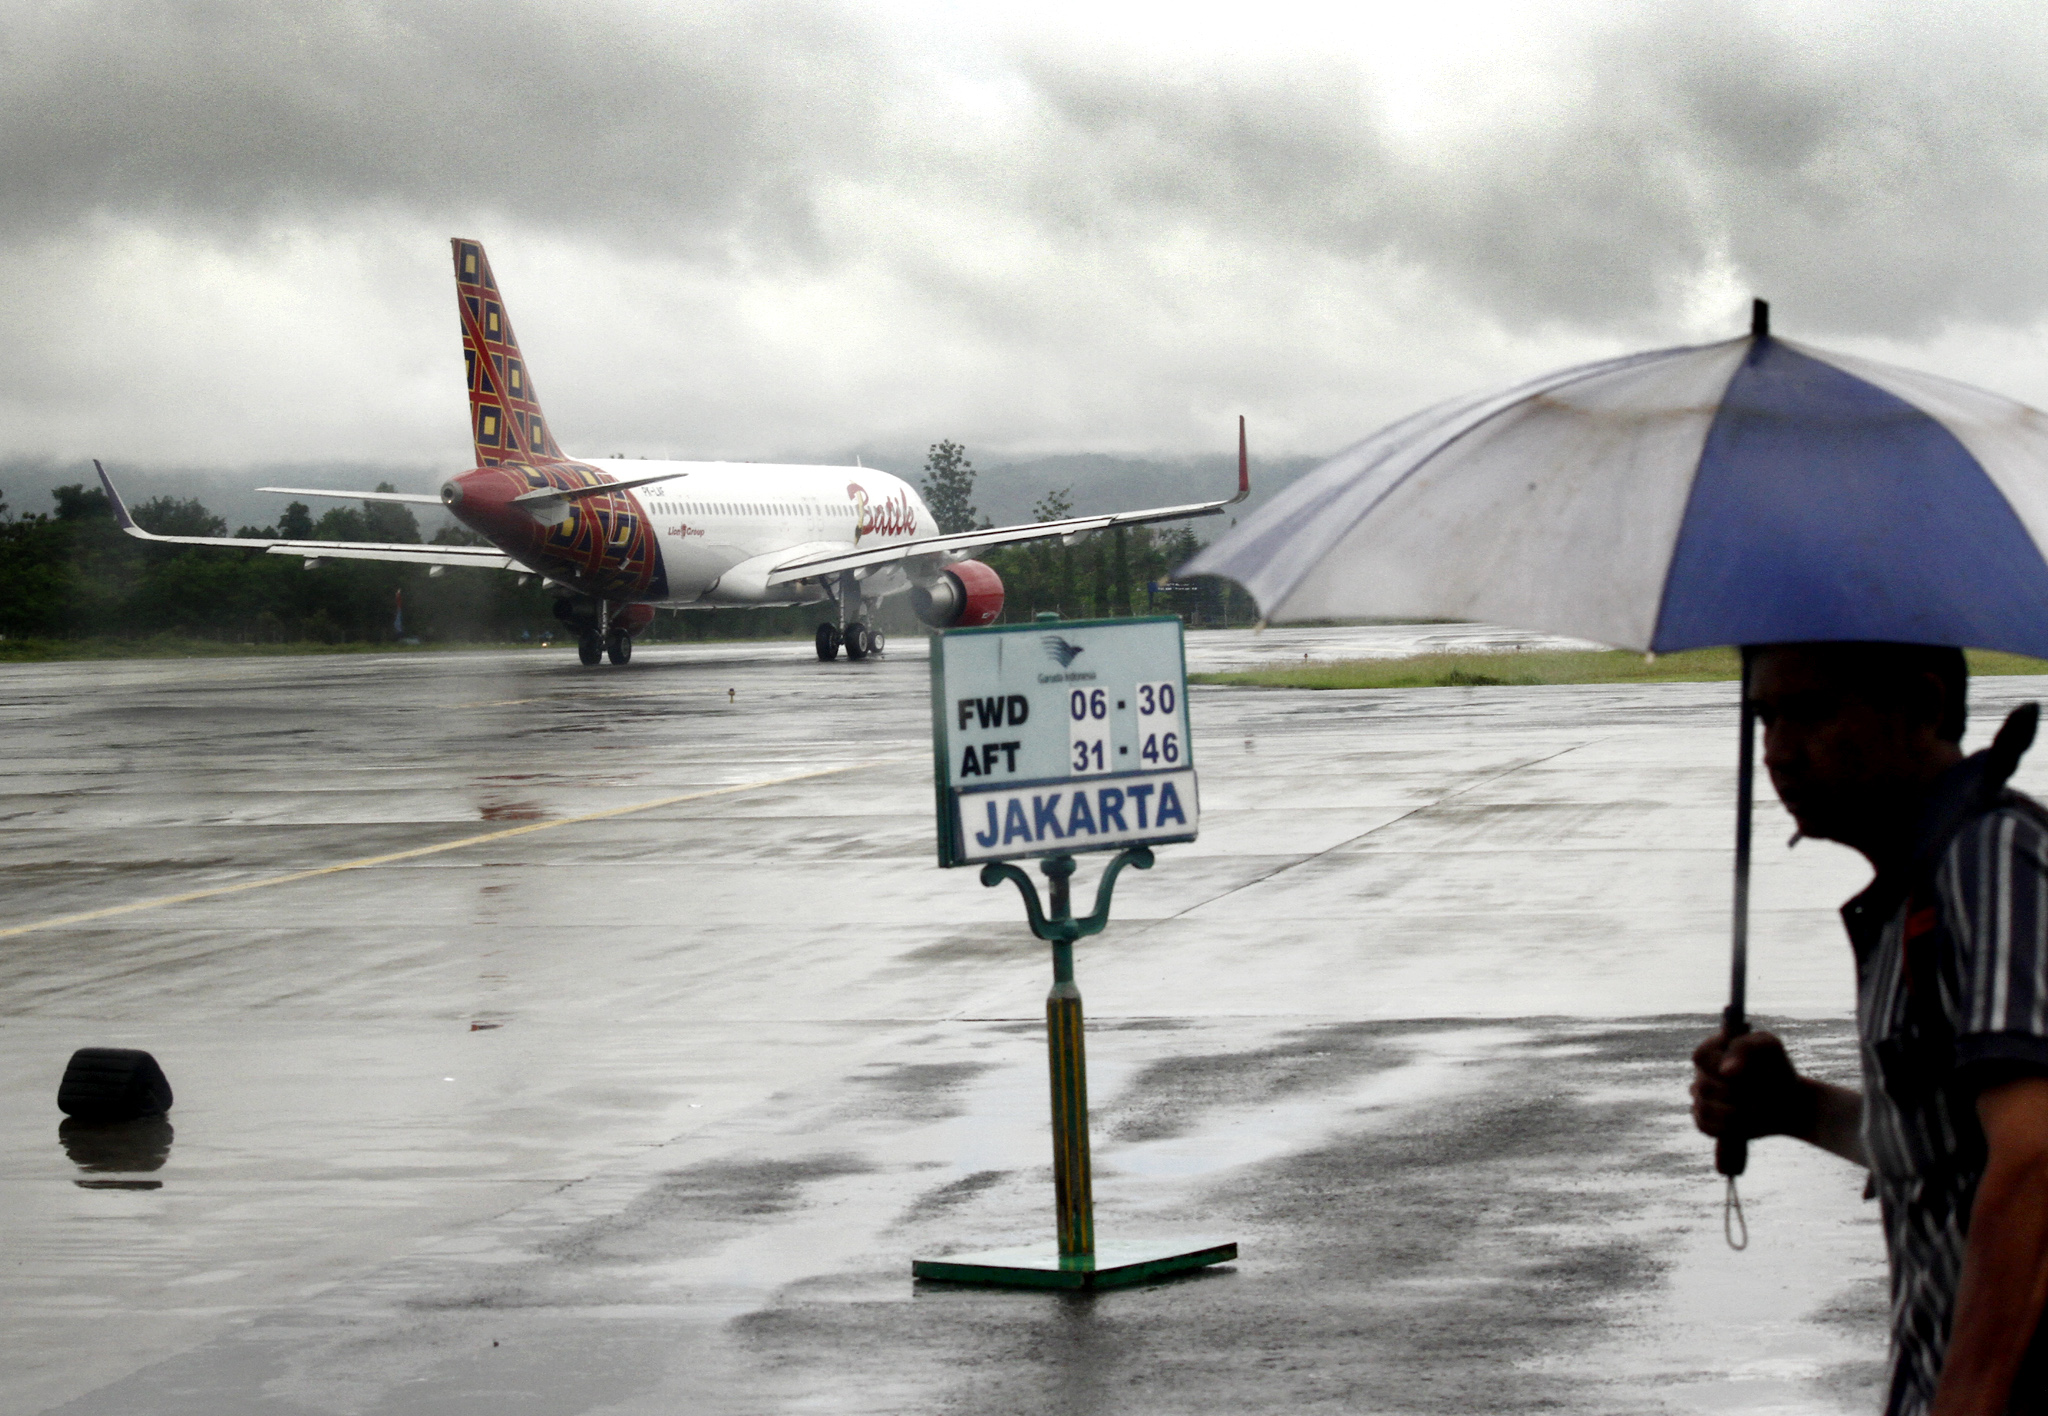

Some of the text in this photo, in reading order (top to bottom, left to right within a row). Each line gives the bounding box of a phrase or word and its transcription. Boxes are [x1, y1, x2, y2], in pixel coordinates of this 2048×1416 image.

[667, 526, 705, 538] Lion Group
[847, 483, 917, 537] Batik
[958, 684, 1175, 730] FWD 06 30
[960, 732, 1179, 778] AFT 31 46
[975, 781, 1187, 848] JAKARTA
